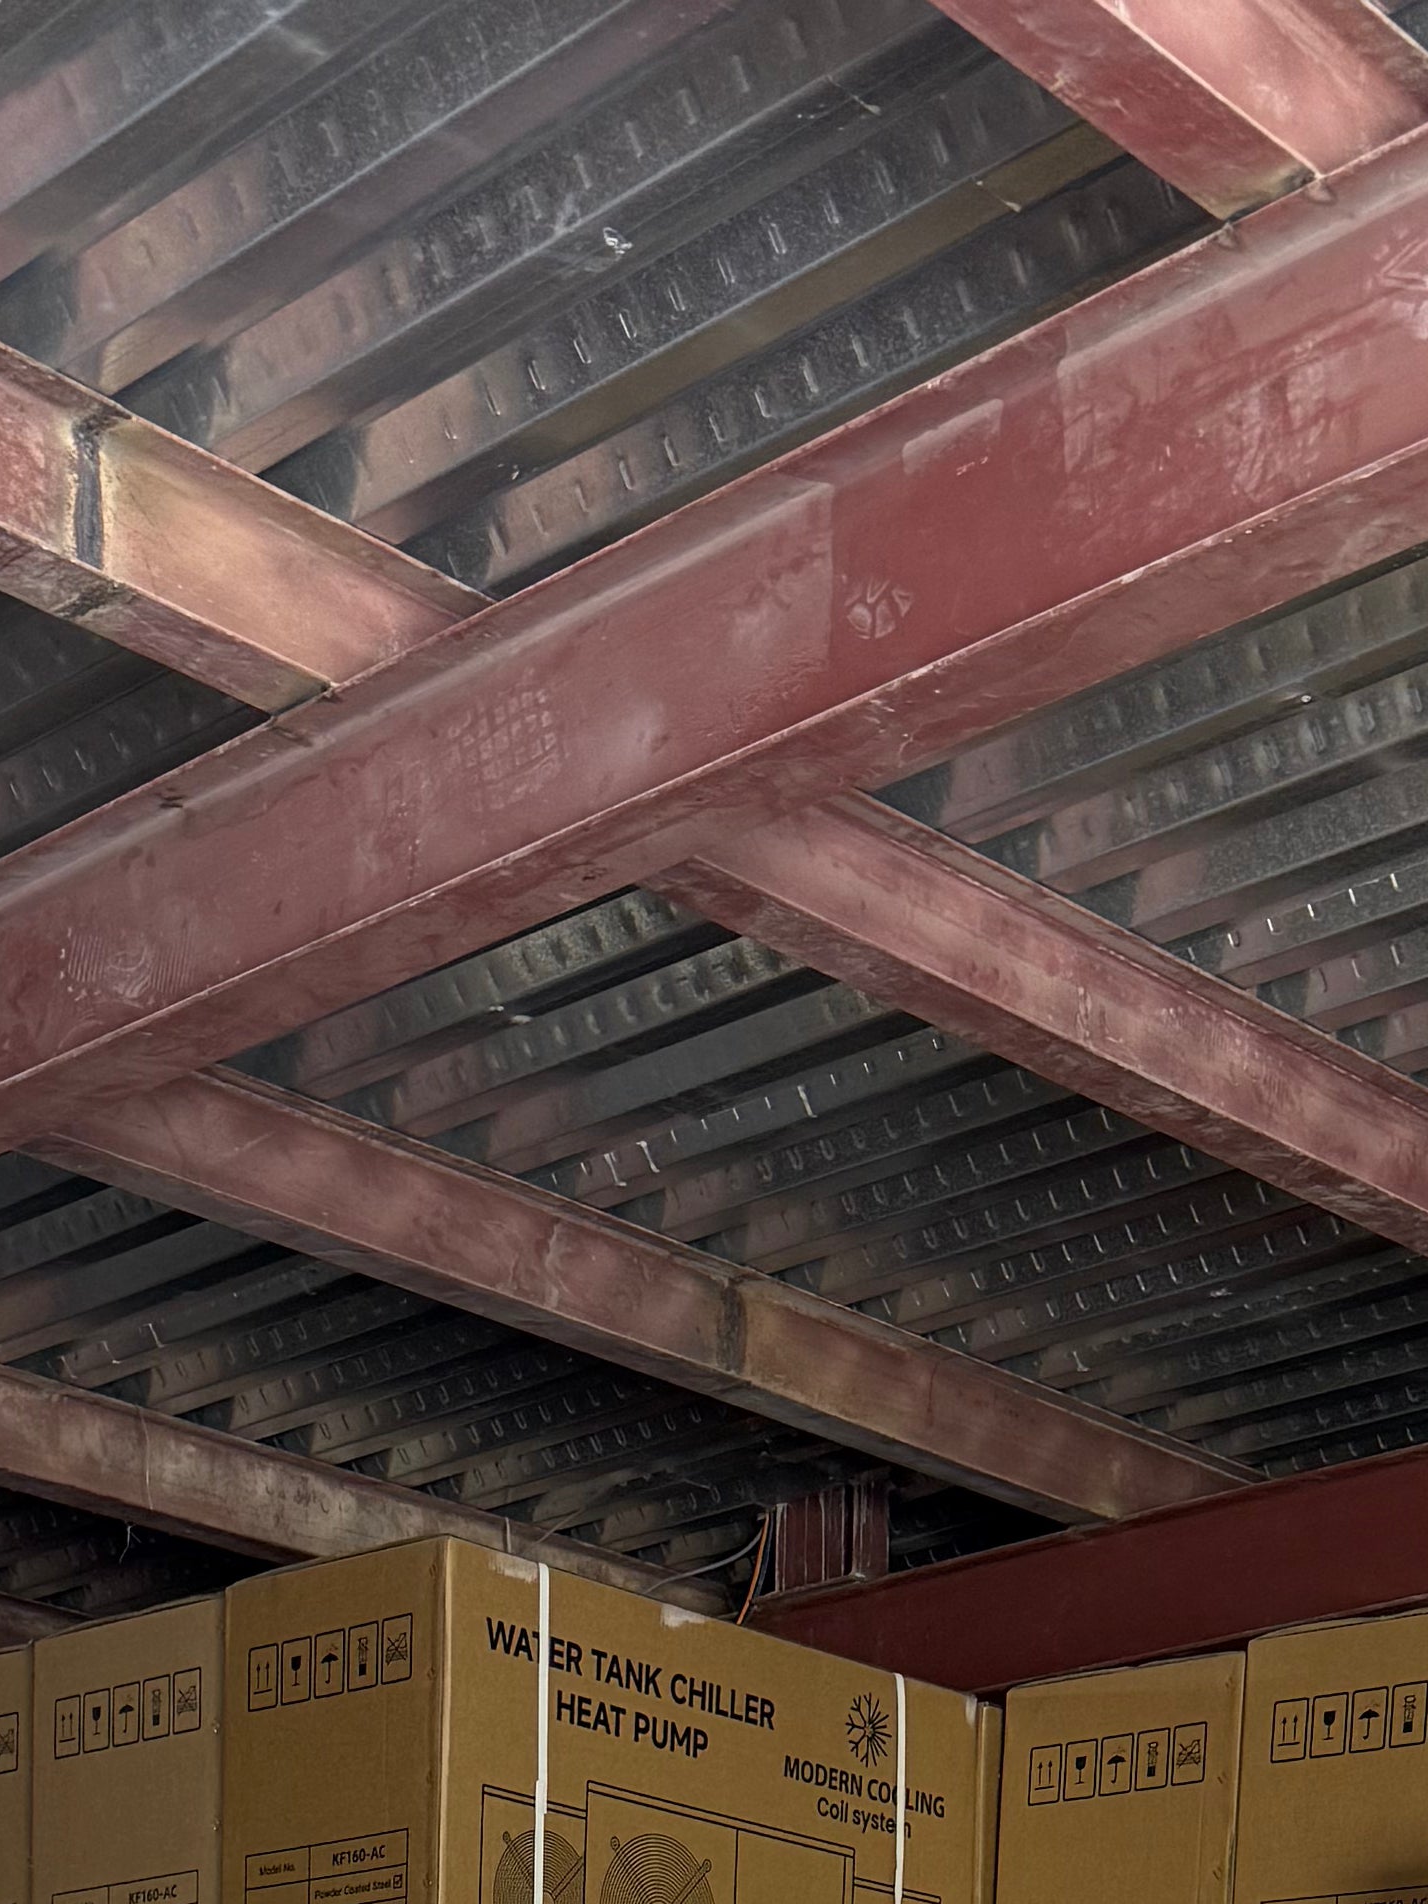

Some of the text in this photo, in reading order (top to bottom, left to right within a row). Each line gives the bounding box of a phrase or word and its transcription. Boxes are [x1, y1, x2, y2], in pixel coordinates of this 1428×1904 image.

[591, 1648, 663, 1699] TANK
[671, 1673, 775, 1730] CHILLER
[557, 1690, 709, 1758] HEAT PUMP
[783, 1756, 863, 1798] MODERN
[817, 1797, 849, 1823] Coil
[332, 1845, 385, 1866] KF160-AC
